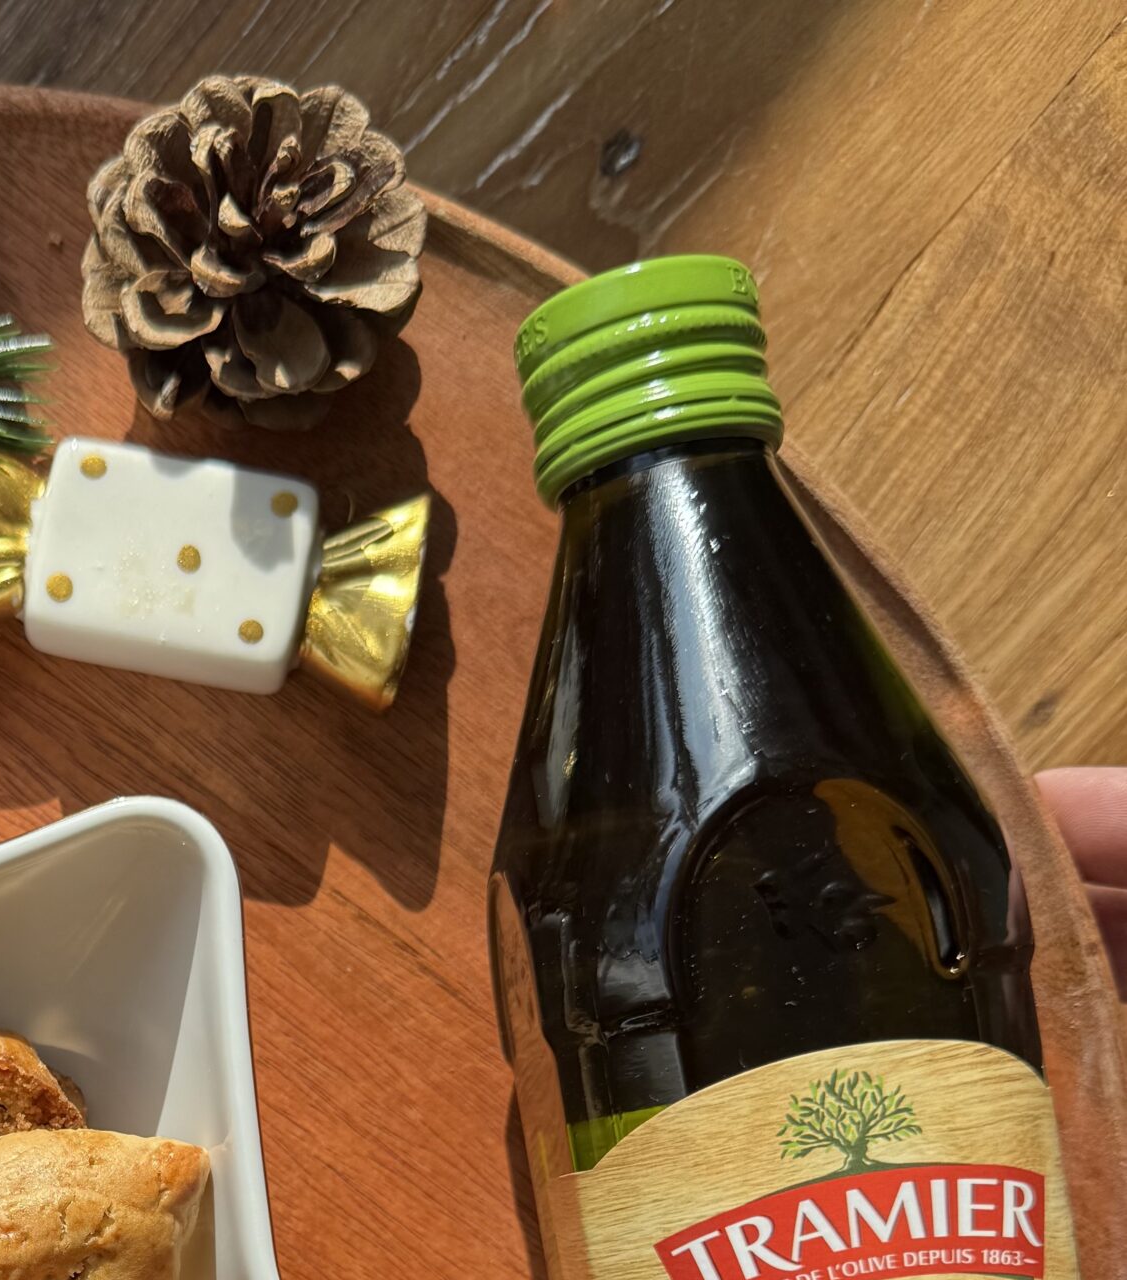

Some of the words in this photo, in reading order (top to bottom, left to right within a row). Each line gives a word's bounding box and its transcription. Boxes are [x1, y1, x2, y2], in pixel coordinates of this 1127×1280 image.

[827, 1252, 898, 1280] L'OLIVE
[902, 1248, 976, 1268] DEPUIS
[981, 1248, 1022, 1267] 1863
